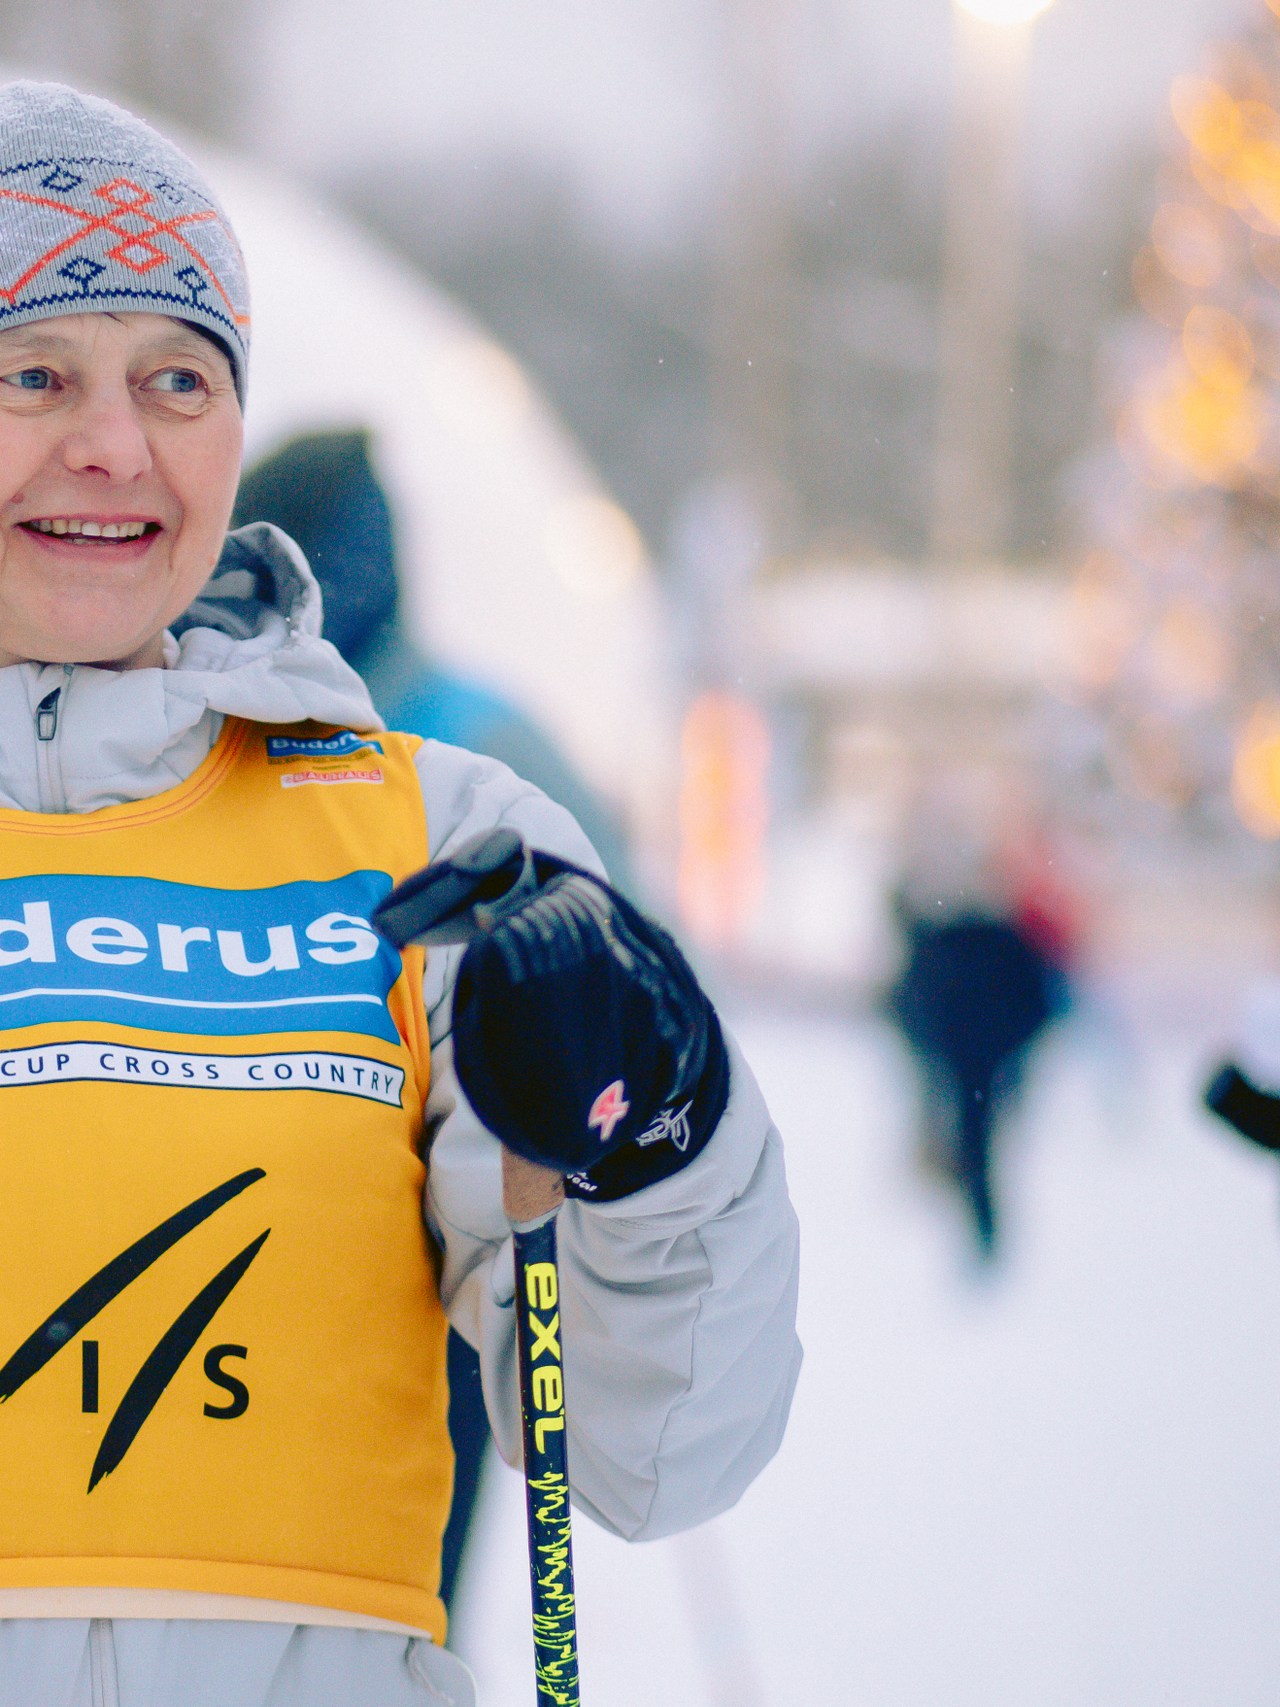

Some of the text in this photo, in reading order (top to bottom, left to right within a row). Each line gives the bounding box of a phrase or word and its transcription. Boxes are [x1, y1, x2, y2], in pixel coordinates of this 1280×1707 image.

[0, 1053, 70, 1077] CUP
[99, 1052, 220, 1080] CROSS
[247, 1061, 395, 1095] COUNTRY
